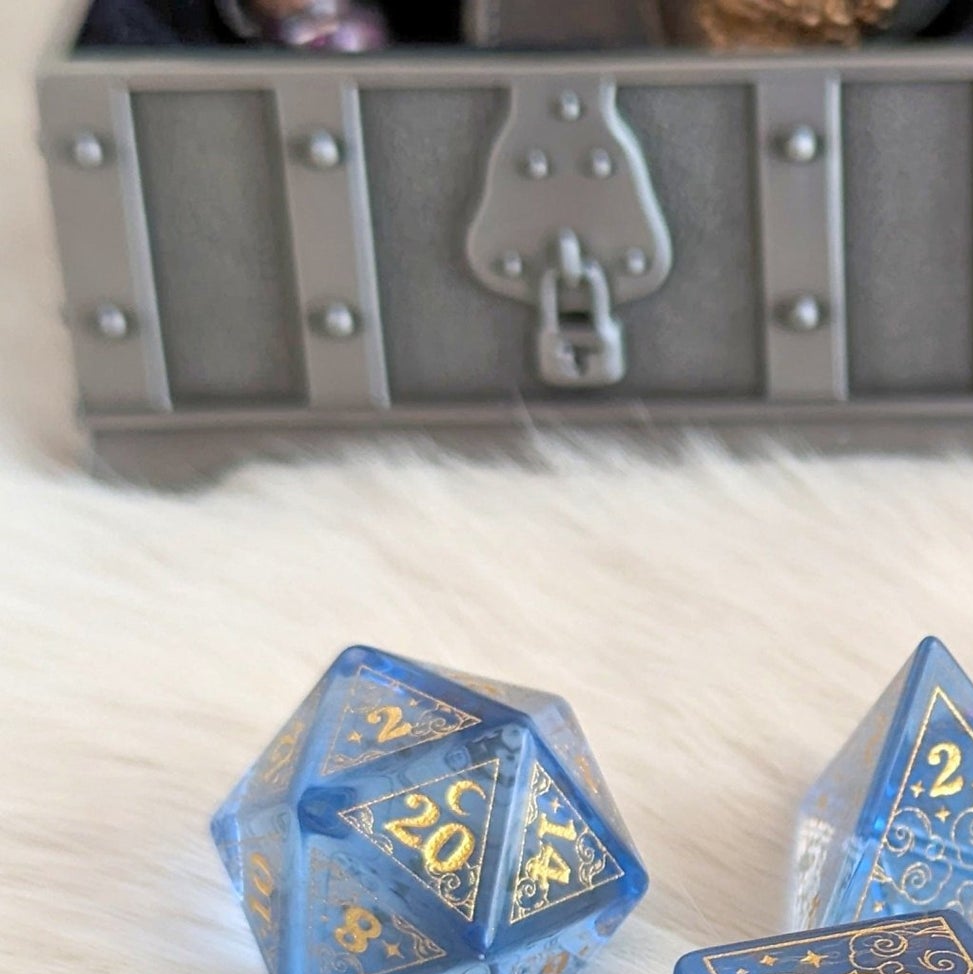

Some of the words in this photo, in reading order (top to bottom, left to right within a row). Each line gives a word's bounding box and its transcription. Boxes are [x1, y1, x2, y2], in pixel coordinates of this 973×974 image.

[366, 705, 412, 743] 2
[927, 742, 964, 798] 2
[383, 793, 475, 874] 20
[530, 812, 577, 891] 14
[335, 906, 382, 954] 8
